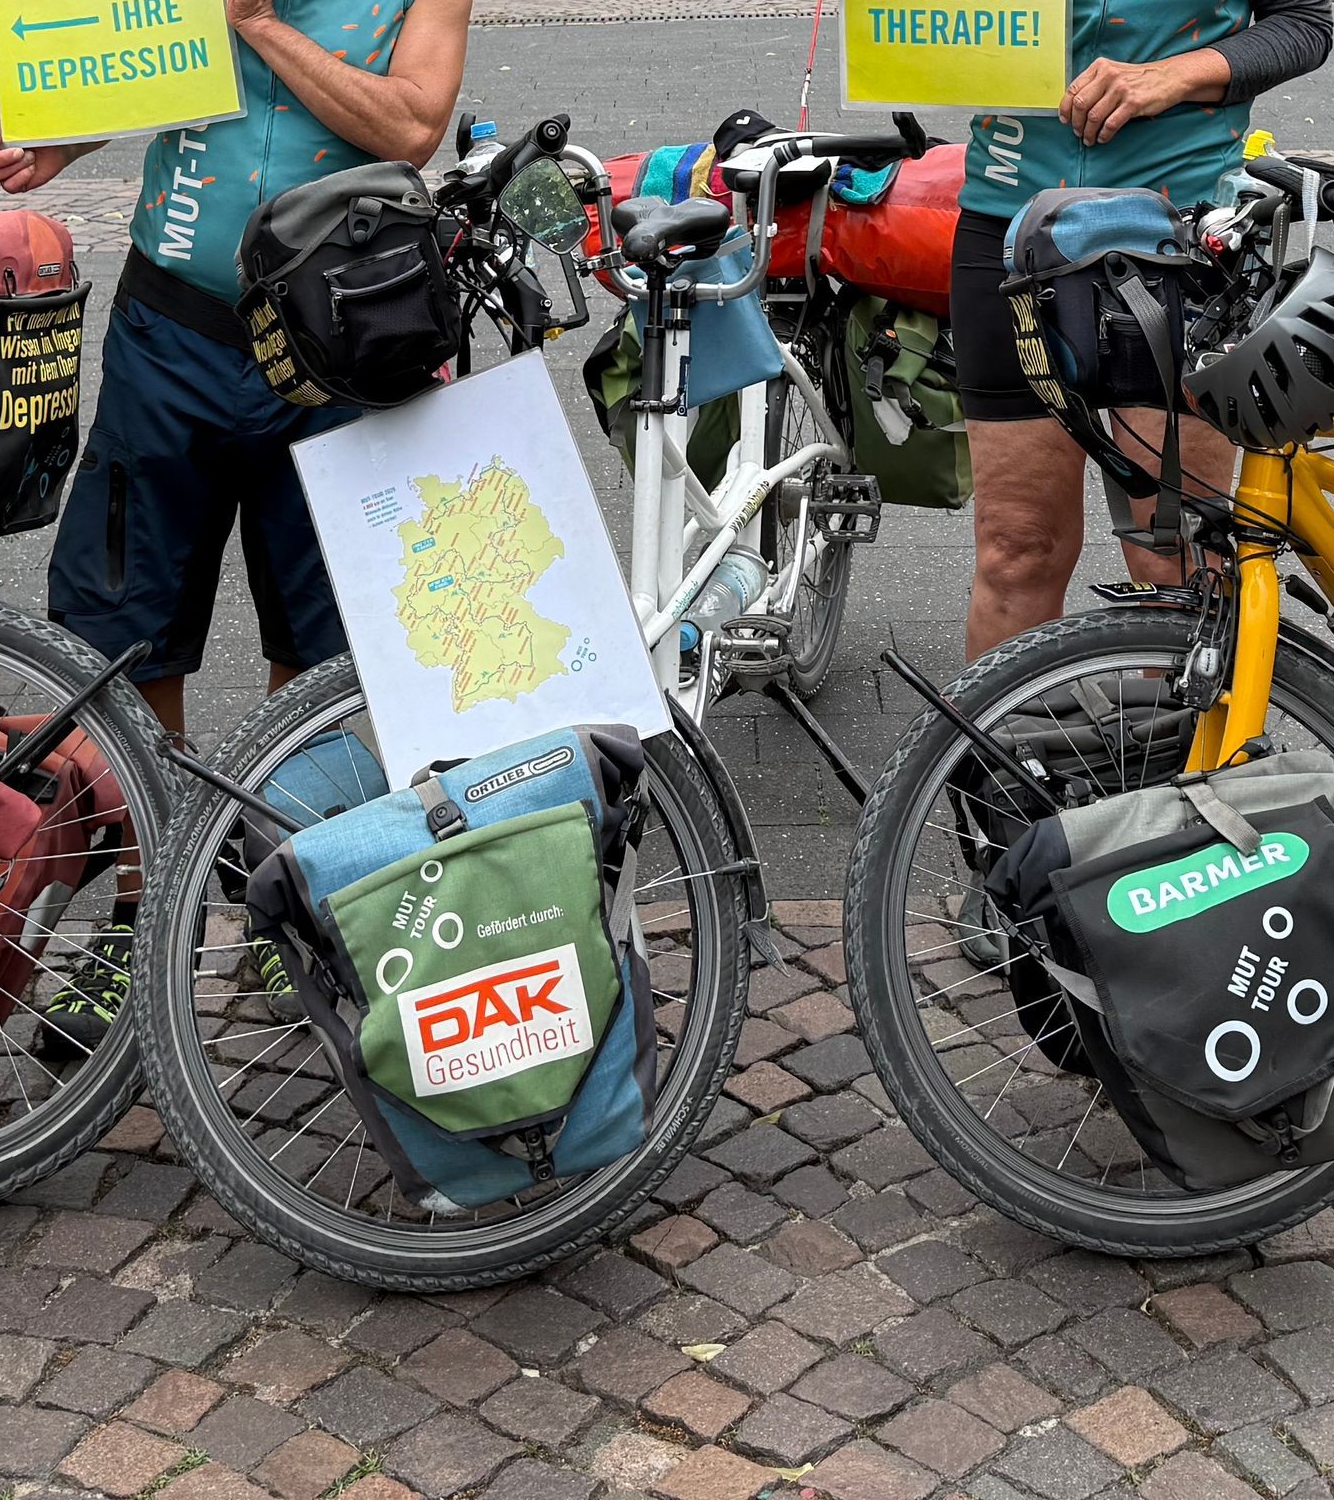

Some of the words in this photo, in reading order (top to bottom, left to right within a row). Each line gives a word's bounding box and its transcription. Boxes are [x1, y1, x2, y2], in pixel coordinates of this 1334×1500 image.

[868, 8, 1040, 47] THERAPIE!
[17, 37, 209, 92] DEPRESSION
[158, 123, 209, 260] MUT-T
[28, 308, 56, 329] mehr
[0, 334, 41, 360] Wissen
[12, 361, 38, 386] mit
[40, 358, 57, 382] dem
[258, 706, 307, 748] SCHWALBE
[469, 767, 526, 798] ORTLIEB
[185, 802, 213, 859] MONDIAL
[1127, 843, 1291, 916] BARMER
[392, 890, 417, 930] MUT
[410, 895, 437, 939] TOUR
[477, 913, 527, 938] Gefördert
[530, 905, 564, 924] durch:
[1227, 945, 1260, 998] MUT
[1251, 956, 1289, 1011] TOUR
[415, 960, 572, 1054] DAK
[426, 1017, 580, 1085] Gesundheit
[654, 1104, 690, 1154] SCHWALBE
